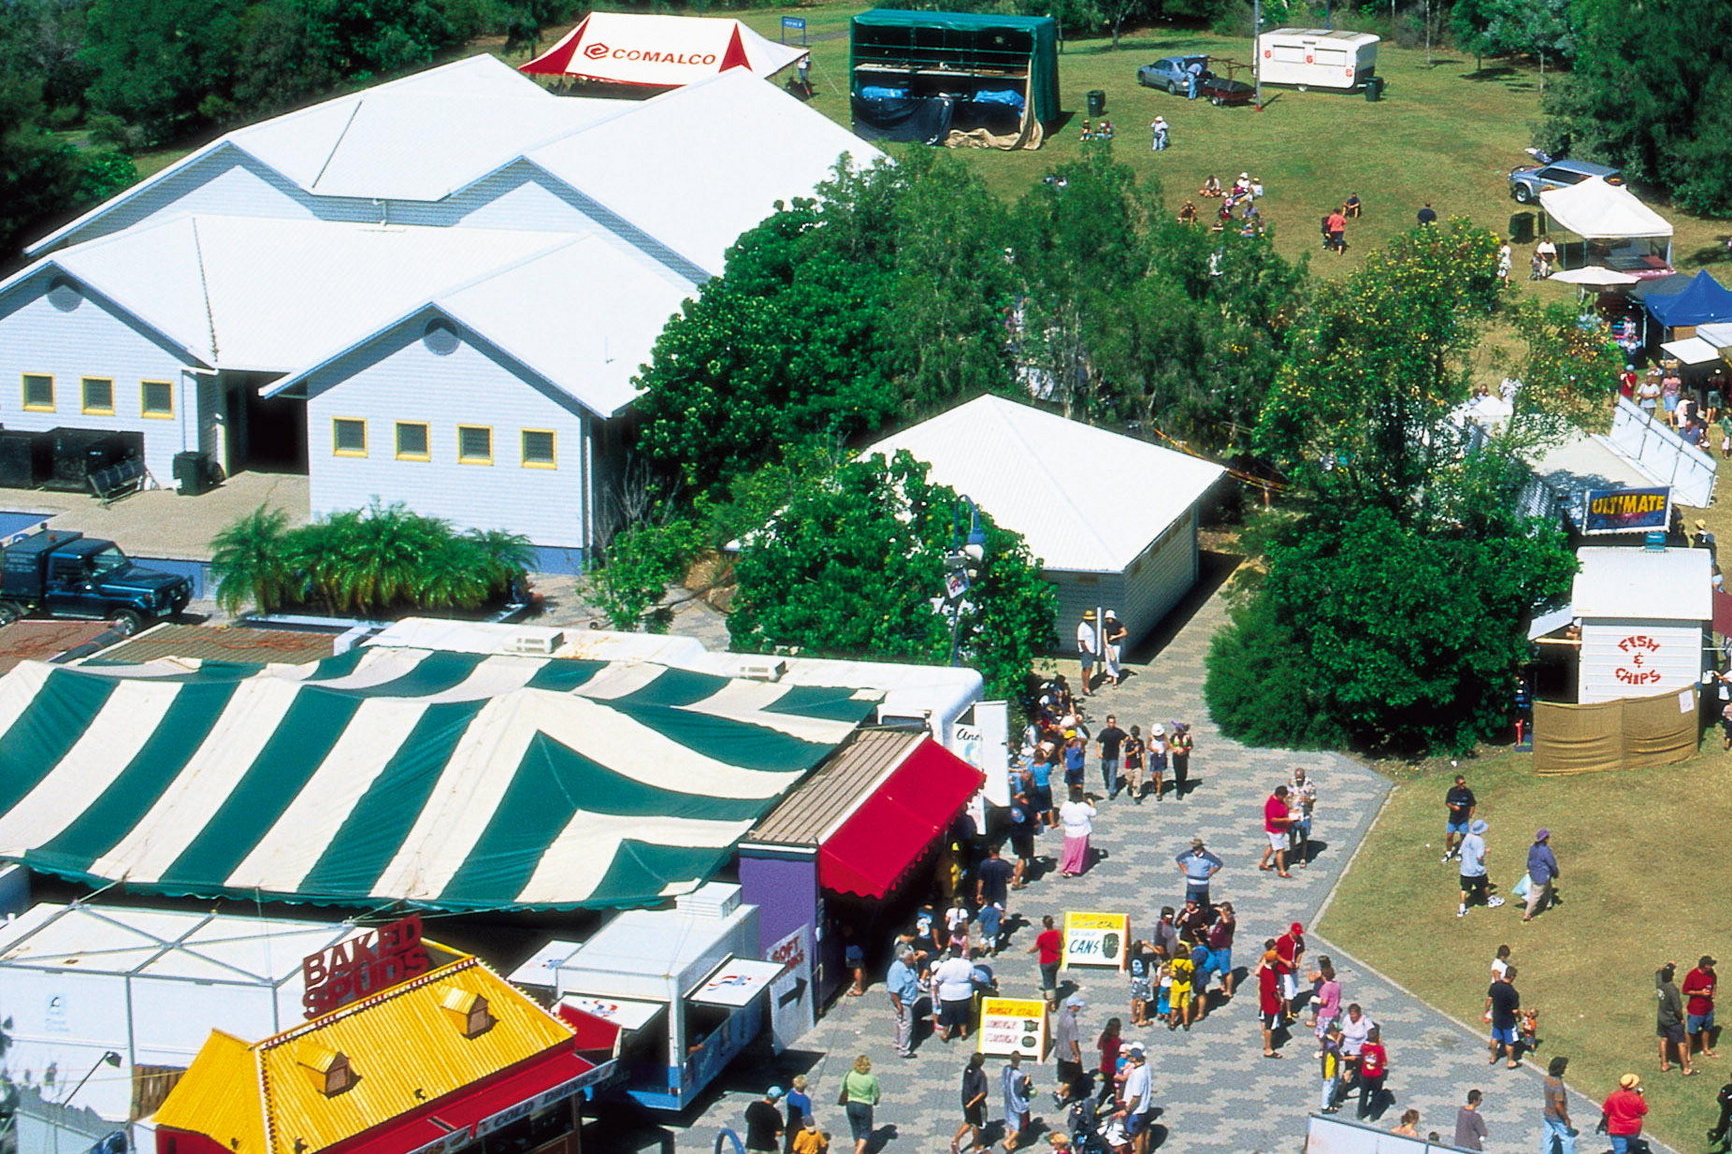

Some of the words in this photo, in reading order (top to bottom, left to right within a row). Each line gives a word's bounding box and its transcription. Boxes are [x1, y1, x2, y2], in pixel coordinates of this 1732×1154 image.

[611, 48, 717, 66] COMALCO
[1592, 494, 1666, 515] ULTIMATE
[1617, 635, 1661, 652] FISH
[1615, 667, 1662, 685] CHIPS
[303, 913, 422, 989] BAKED
[772, 935, 800, 961] SOFT
[1069, 939, 1100, 954] CANS
[303, 945, 430, 1020] SPUDS
